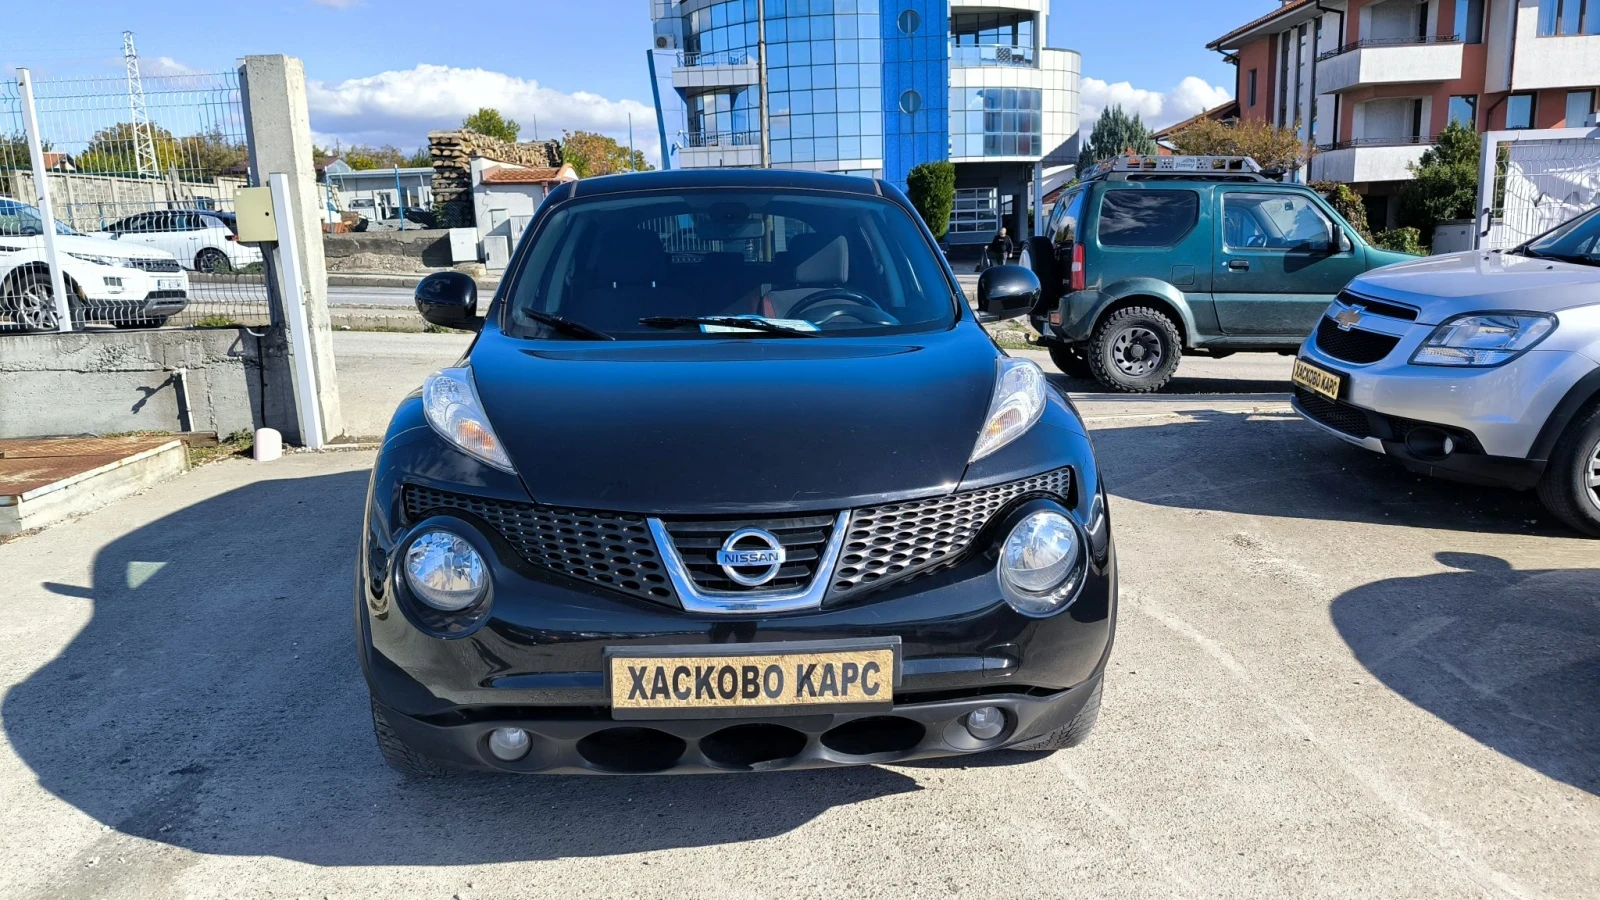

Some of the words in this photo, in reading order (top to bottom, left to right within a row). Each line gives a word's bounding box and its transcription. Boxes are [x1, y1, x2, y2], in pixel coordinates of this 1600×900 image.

[1294, 363, 1321, 387] ХАСКОВО
[1321, 374, 1337, 395] КАРС
[724, 553, 779, 563] NISSAN
[627, 665, 784, 700] ХАСКОВО
[796, 661, 881, 698] КАРС
